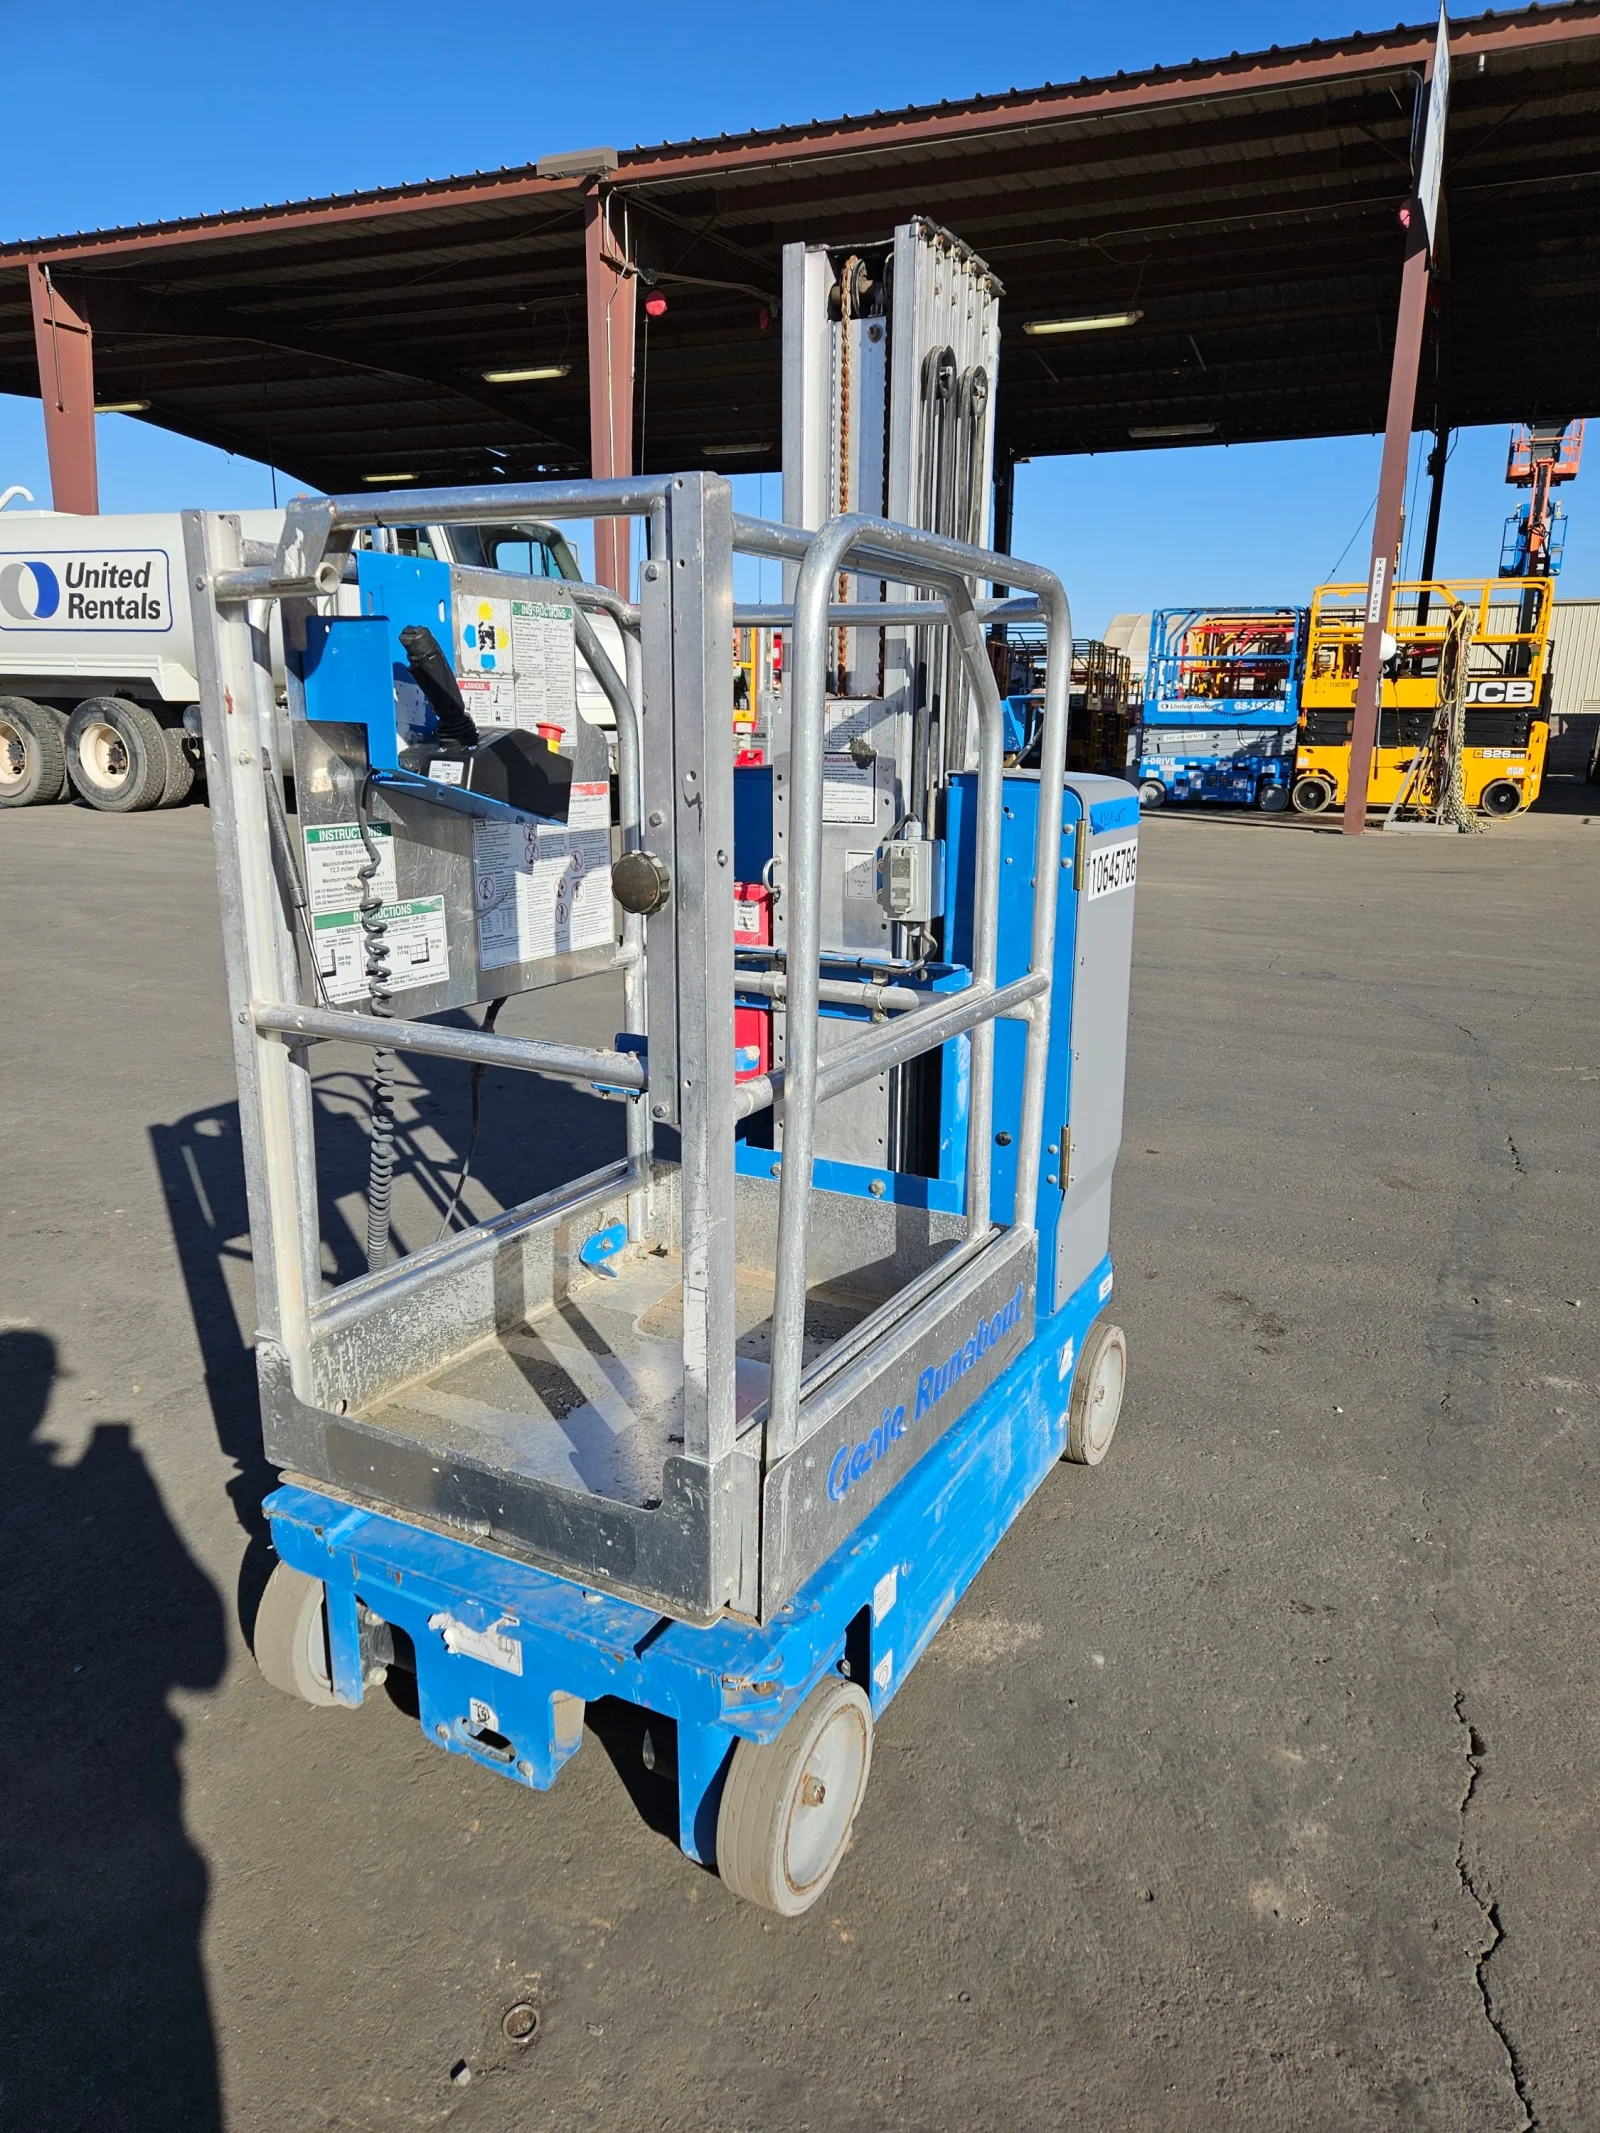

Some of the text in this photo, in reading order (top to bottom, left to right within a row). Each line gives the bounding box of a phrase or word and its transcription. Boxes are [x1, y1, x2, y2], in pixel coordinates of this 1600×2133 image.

[65, 561, 151, 588] United
[1375, 559, 1383, 584] YARD
[68, 592, 161, 620] Rentals
[1464, 681, 1534, 703] JCB
[1142, 757, 1175, 765] E-DRIVE
[318, 825, 383, 842] INSTRUCTNS
[1092, 846, 1137, 895] 10645786
[354, 904, 412, 923] INUCTIONS
[827, 1281, 1024, 1502] Genie Runabout
